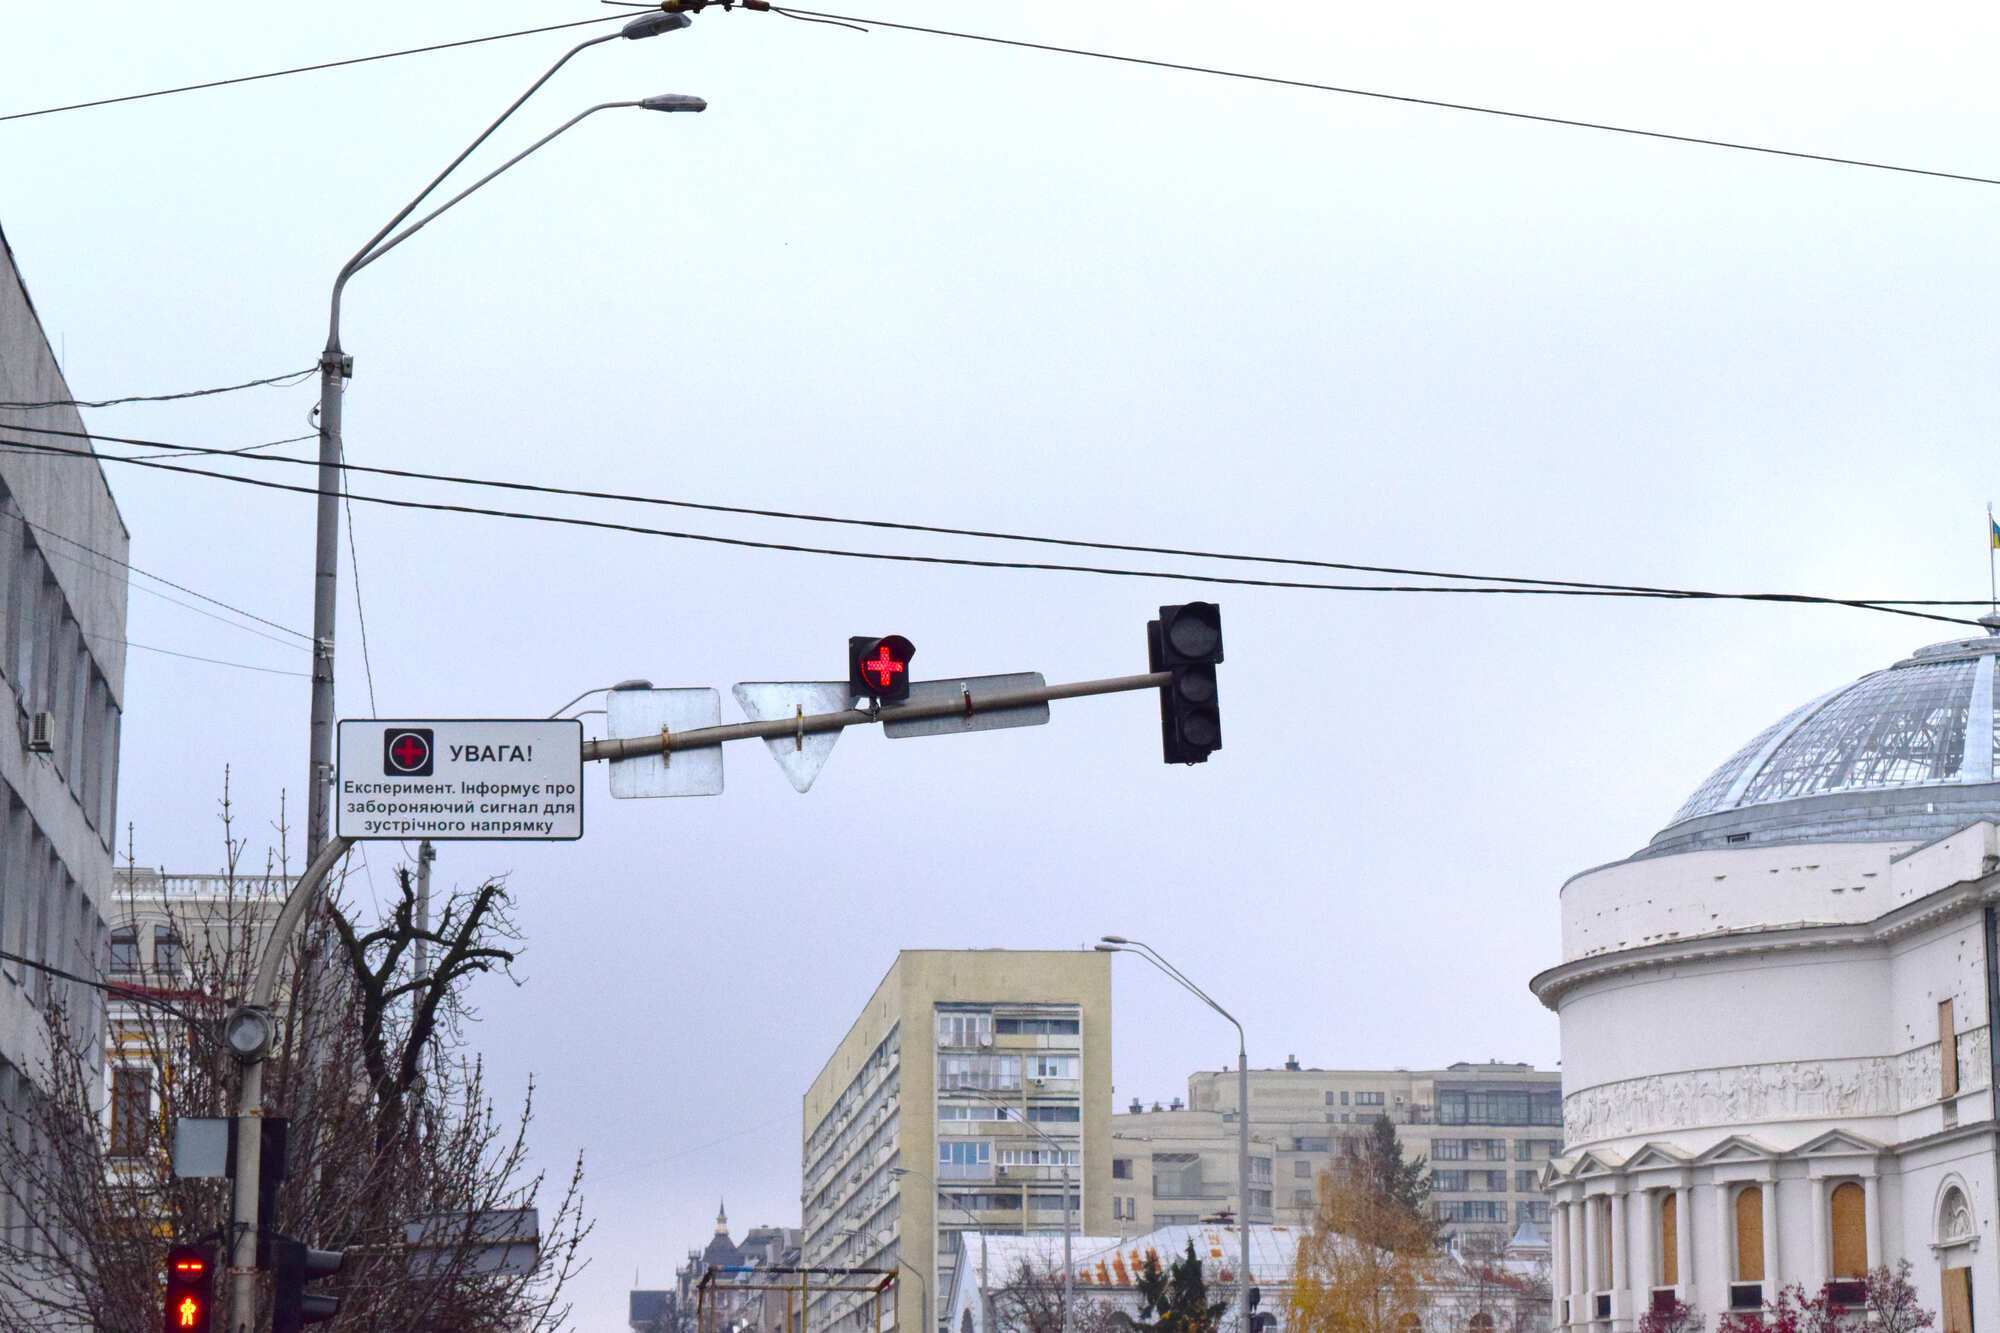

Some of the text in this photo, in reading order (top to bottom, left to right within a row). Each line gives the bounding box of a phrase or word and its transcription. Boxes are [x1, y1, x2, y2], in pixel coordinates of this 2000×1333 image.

[450, 745, 532, 762] УВАГА!
[344, 781, 576, 797] Експеримент. Інформує про
[347, 800, 575, 816] забороняючий сигнал для
[364, 818, 554, 835] зустрічного напрямку
